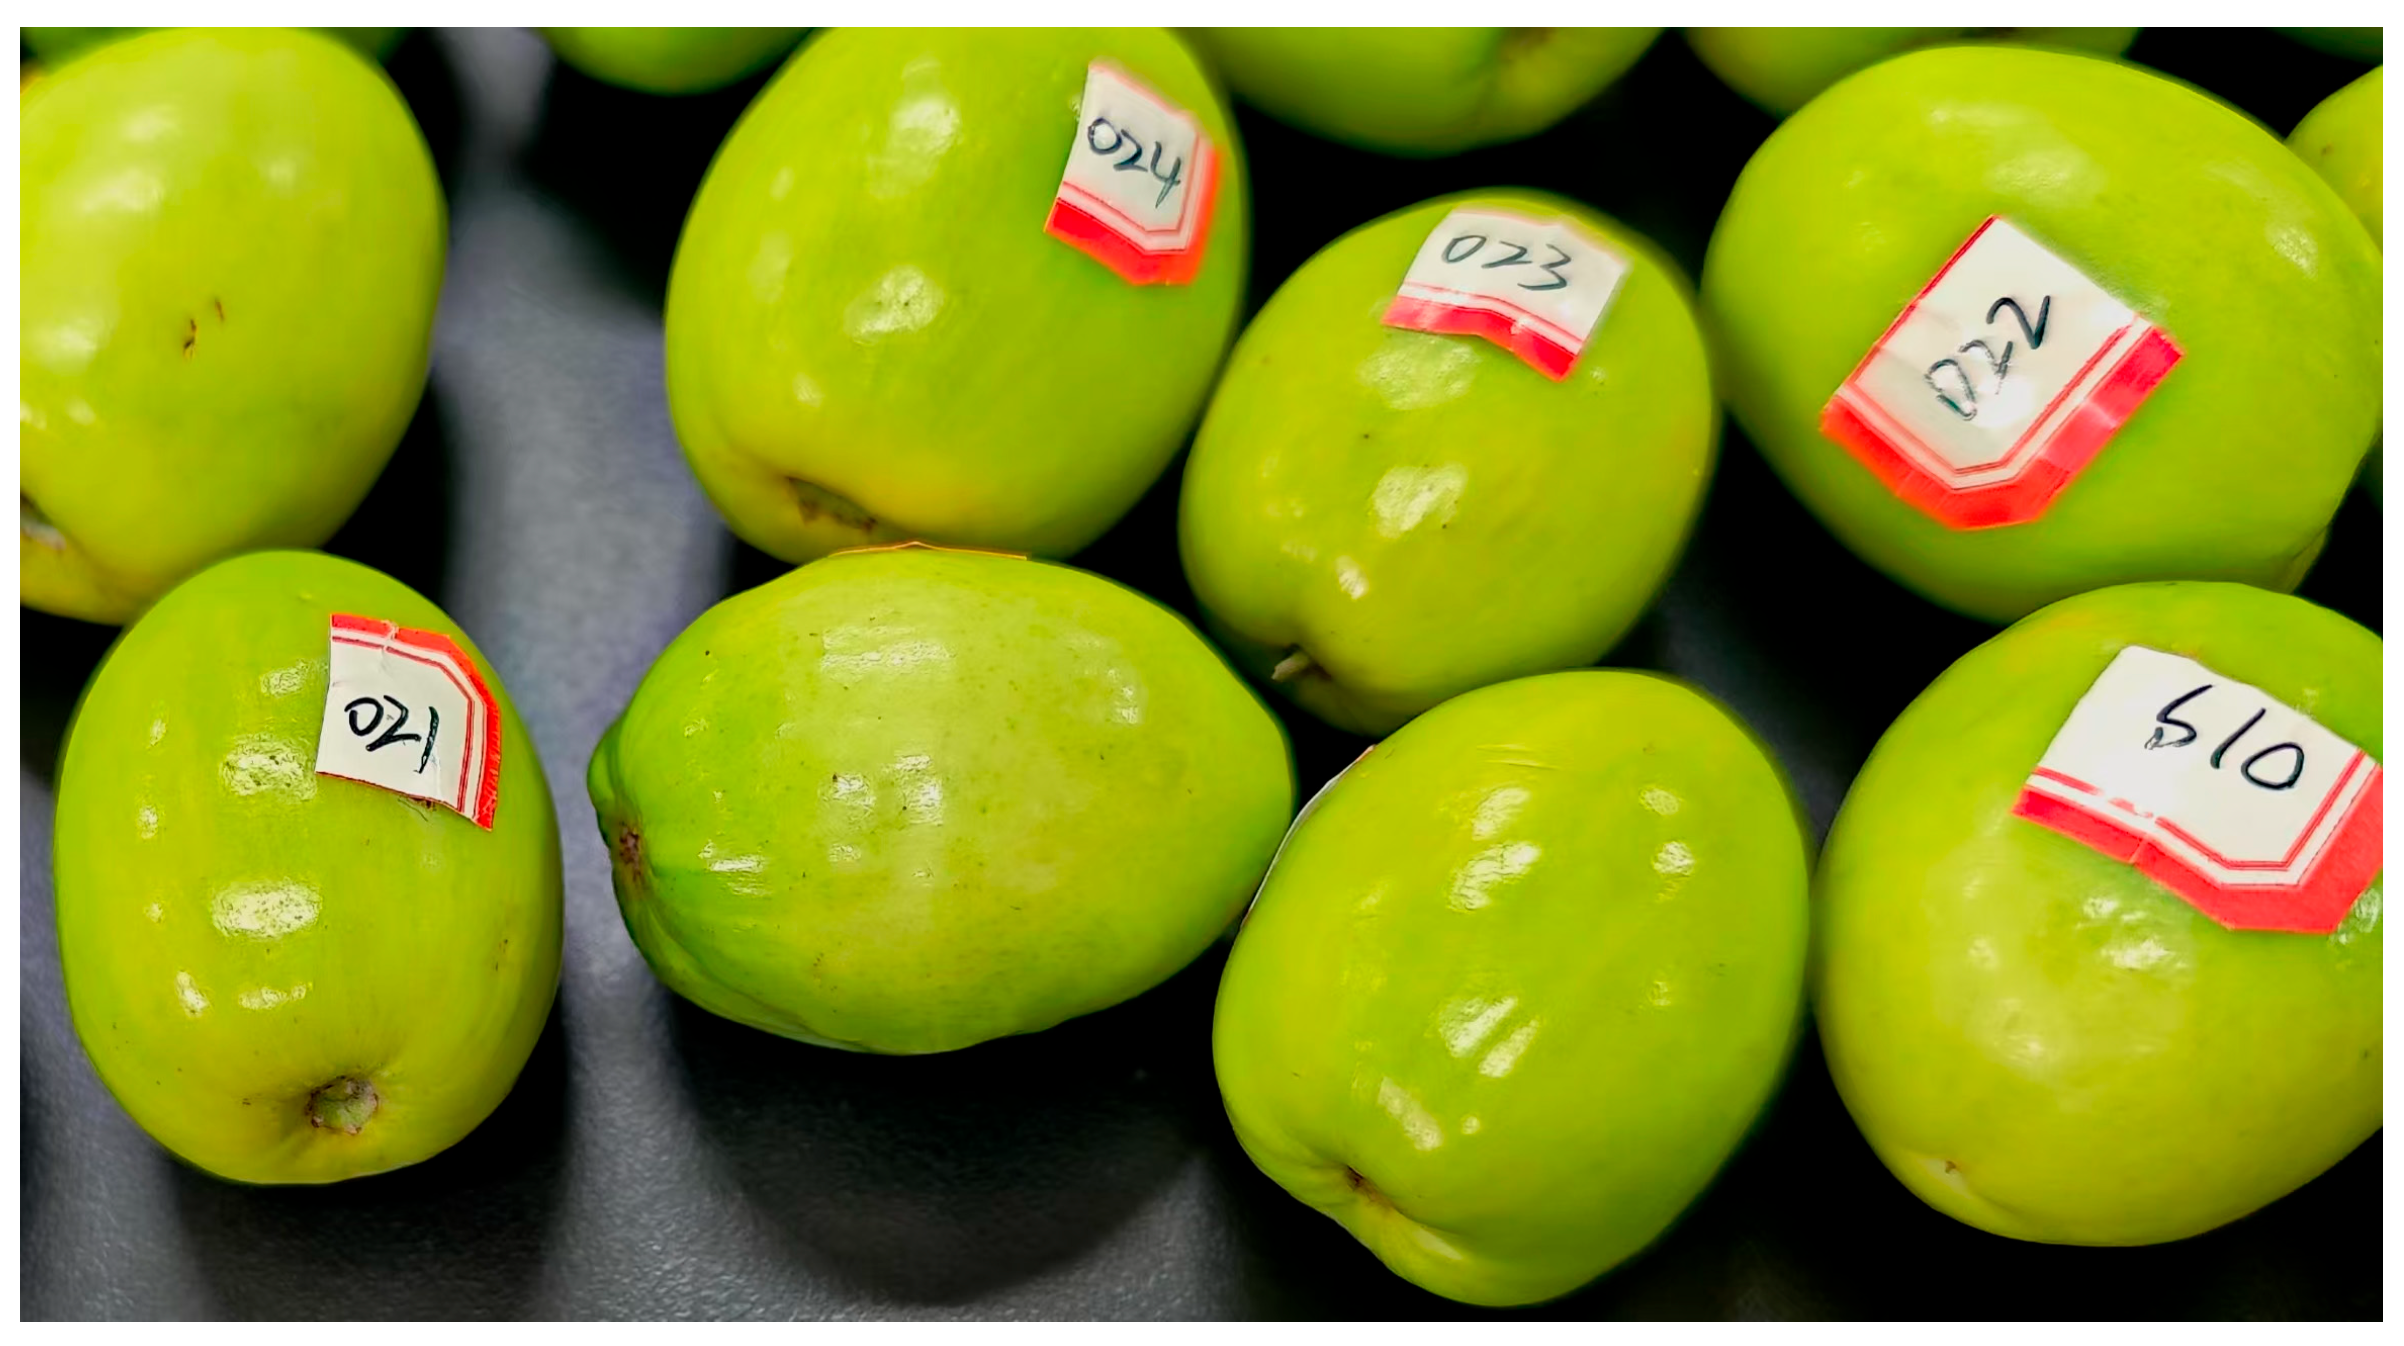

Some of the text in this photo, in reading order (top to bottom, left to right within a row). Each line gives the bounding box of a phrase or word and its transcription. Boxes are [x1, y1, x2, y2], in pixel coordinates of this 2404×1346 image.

[1087, 117, 1182, 209] 024
[1440, 234, 1572, 291] 023
[1924, 295, 2051, 421] 022
[344, 694, 440, 774] 021
